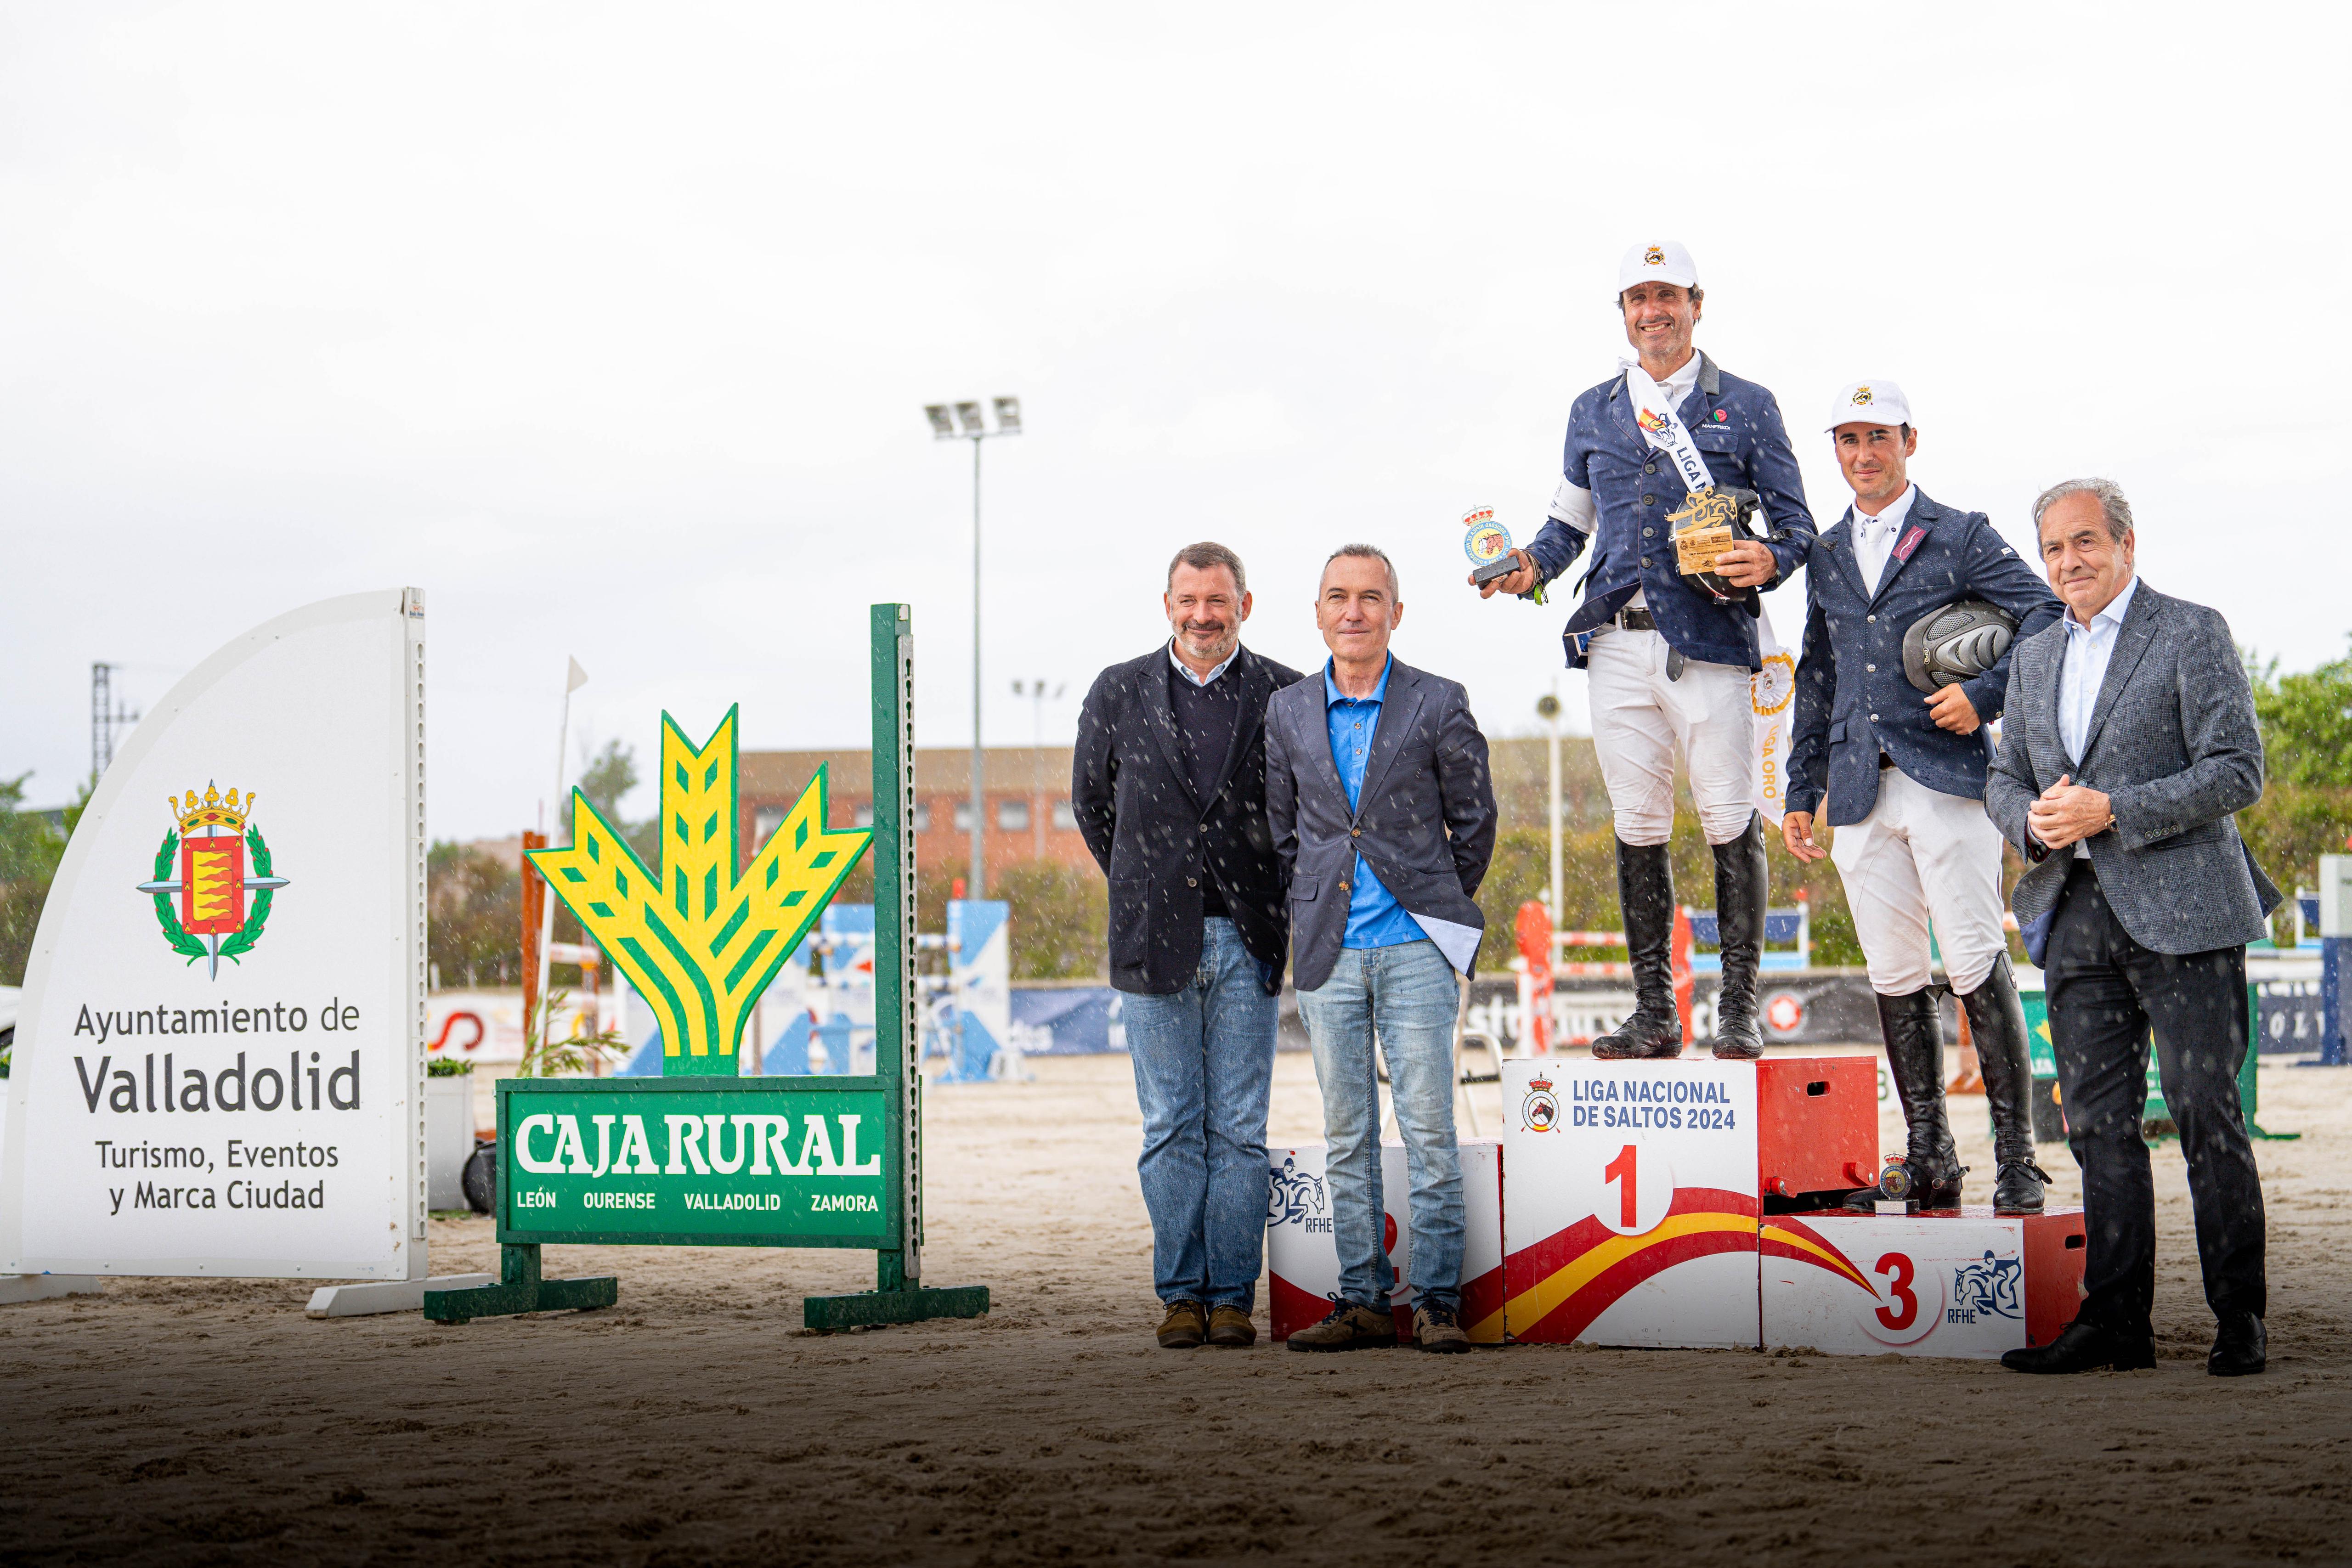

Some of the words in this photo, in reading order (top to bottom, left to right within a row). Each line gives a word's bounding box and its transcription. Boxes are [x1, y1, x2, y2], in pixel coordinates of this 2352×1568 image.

[1677, 446, 1702, 481] LIGA
[1762, 725, 1779, 758] LIGA
[1762, 761, 1776, 799] ORO
[74, 1000, 307, 1044] Ayuntamiento
[321, 997, 359, 1031] de
[74, 1049, 360, 1113] Valladolid
[1573, 1080, 1619, 1102] LIGA
[1624, 1081, 1730, 1103] NACIONAL
[1573, 1105, 1599, 1127] DE
[1604, 1105, 1682, 1129] SALTOS
[1687, 1108, 1736, 1130] 2024
[95, 1140, 214, 1174] Turismo,
[228, 1140, 339, 1168] Eventos
[515, 1114, 659, 1178] CAJA
[665, 1114, 881, 1176] RURAL
[109, 1188, 124, 1216] y
[134, 1181, 216, 1209] Marca
[227, 1179, 324, 1209] Ciudad
[517, 1188, 556, 1208] LEÓN
[583, 1192, 655, 1209] OURENSE
[684, 1194, 780, 1210] VALLADOLID
[811, 1194, 878, 1212] ZAMORA
[1606, 1145, 1637, 1228] 1
[1306, 1218, 1333, 1233] RFHE
[1875, 1252, 1917, 1330] 3
[1948, 1309, 1976, 1324] RFHE
